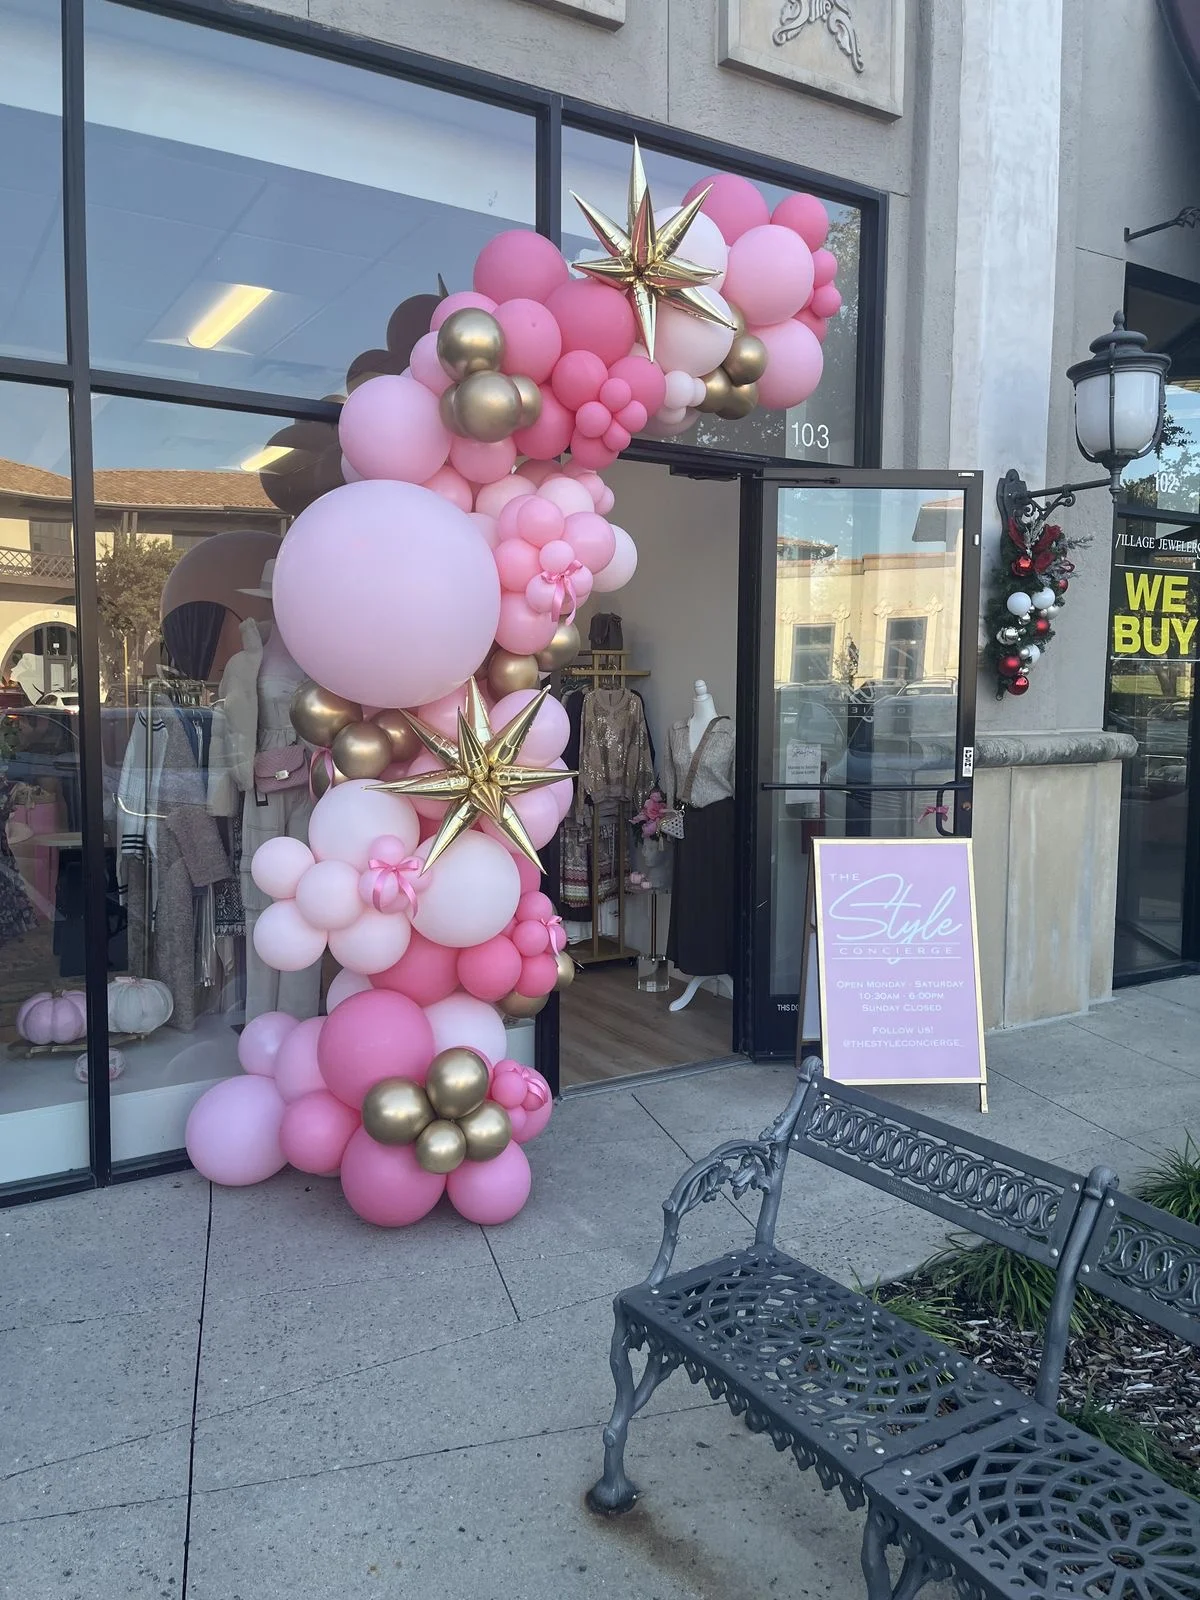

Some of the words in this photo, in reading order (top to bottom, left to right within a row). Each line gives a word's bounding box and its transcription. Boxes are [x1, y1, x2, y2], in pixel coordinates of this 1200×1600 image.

[791, 421, 829, 448] 103
[1154, 472, 1176, 494] 102
[1125, 572, 1188, 613] WE
[1114, 615, 1198, 655] BUY
[964, 749, 972, 767] PUSH
[829, 873, 861, 881] THE
[829, 873, 962, 965] Style
[839, 947, 953, 955] CONCIERGE
